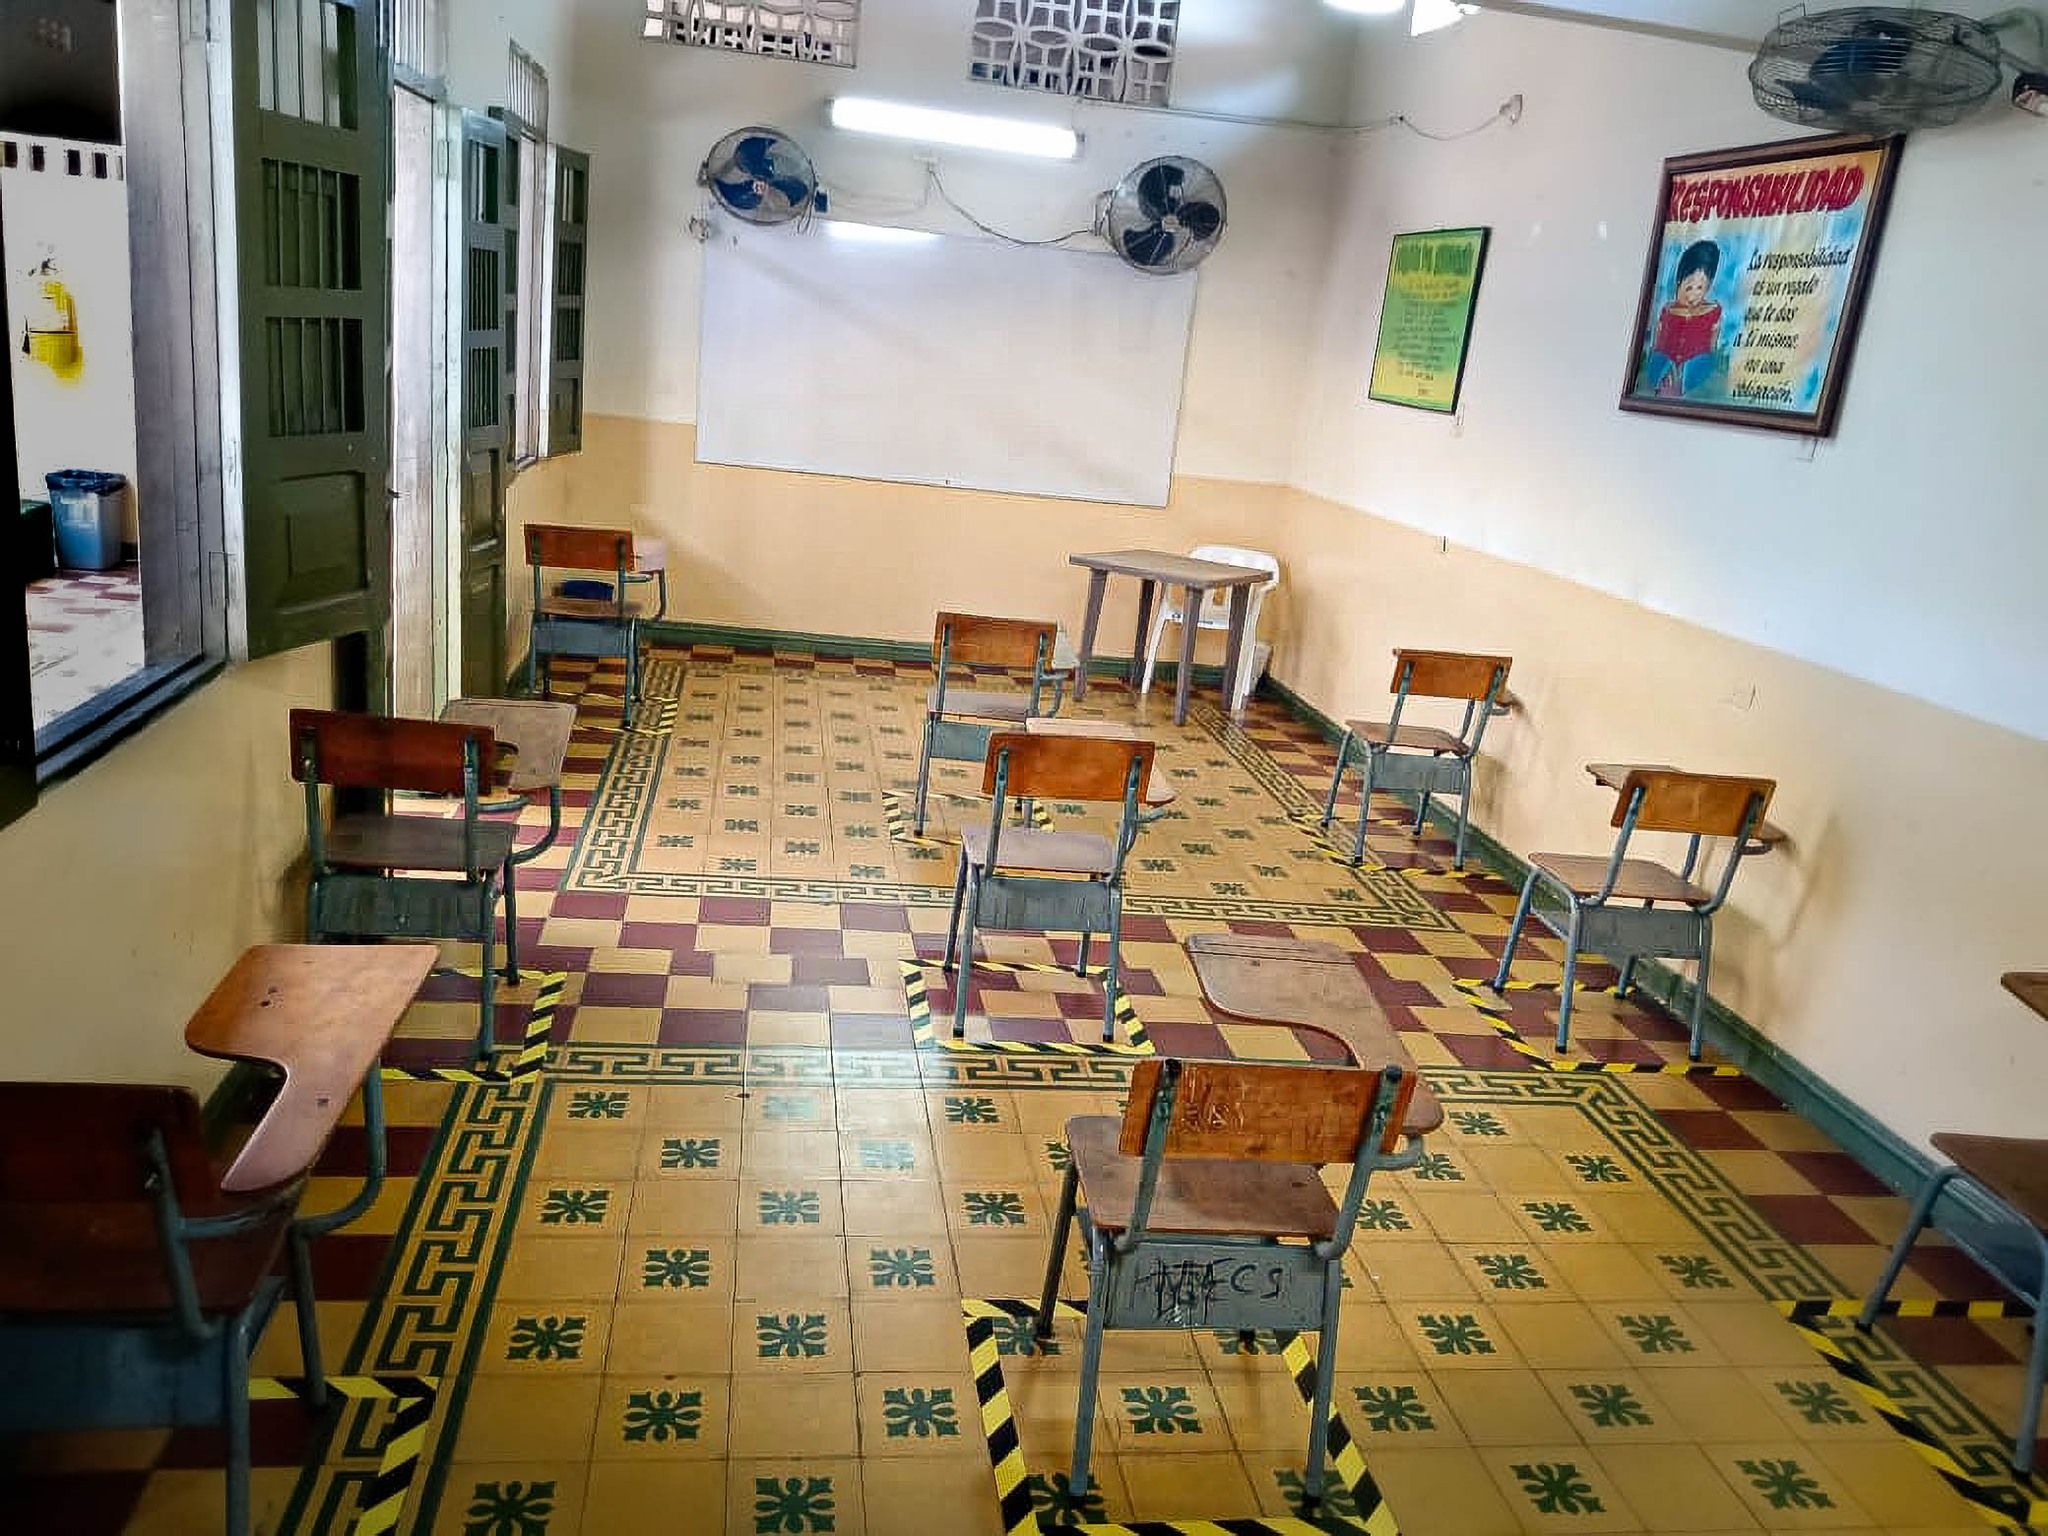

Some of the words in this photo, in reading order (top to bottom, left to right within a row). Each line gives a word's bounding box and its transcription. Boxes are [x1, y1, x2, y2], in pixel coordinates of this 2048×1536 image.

[1665, 165, 1864, 223] RESPONSABILIDAD
[1747, 249, 1761, 273] La
[1763, 244, 1853, 274] responsabilidad
